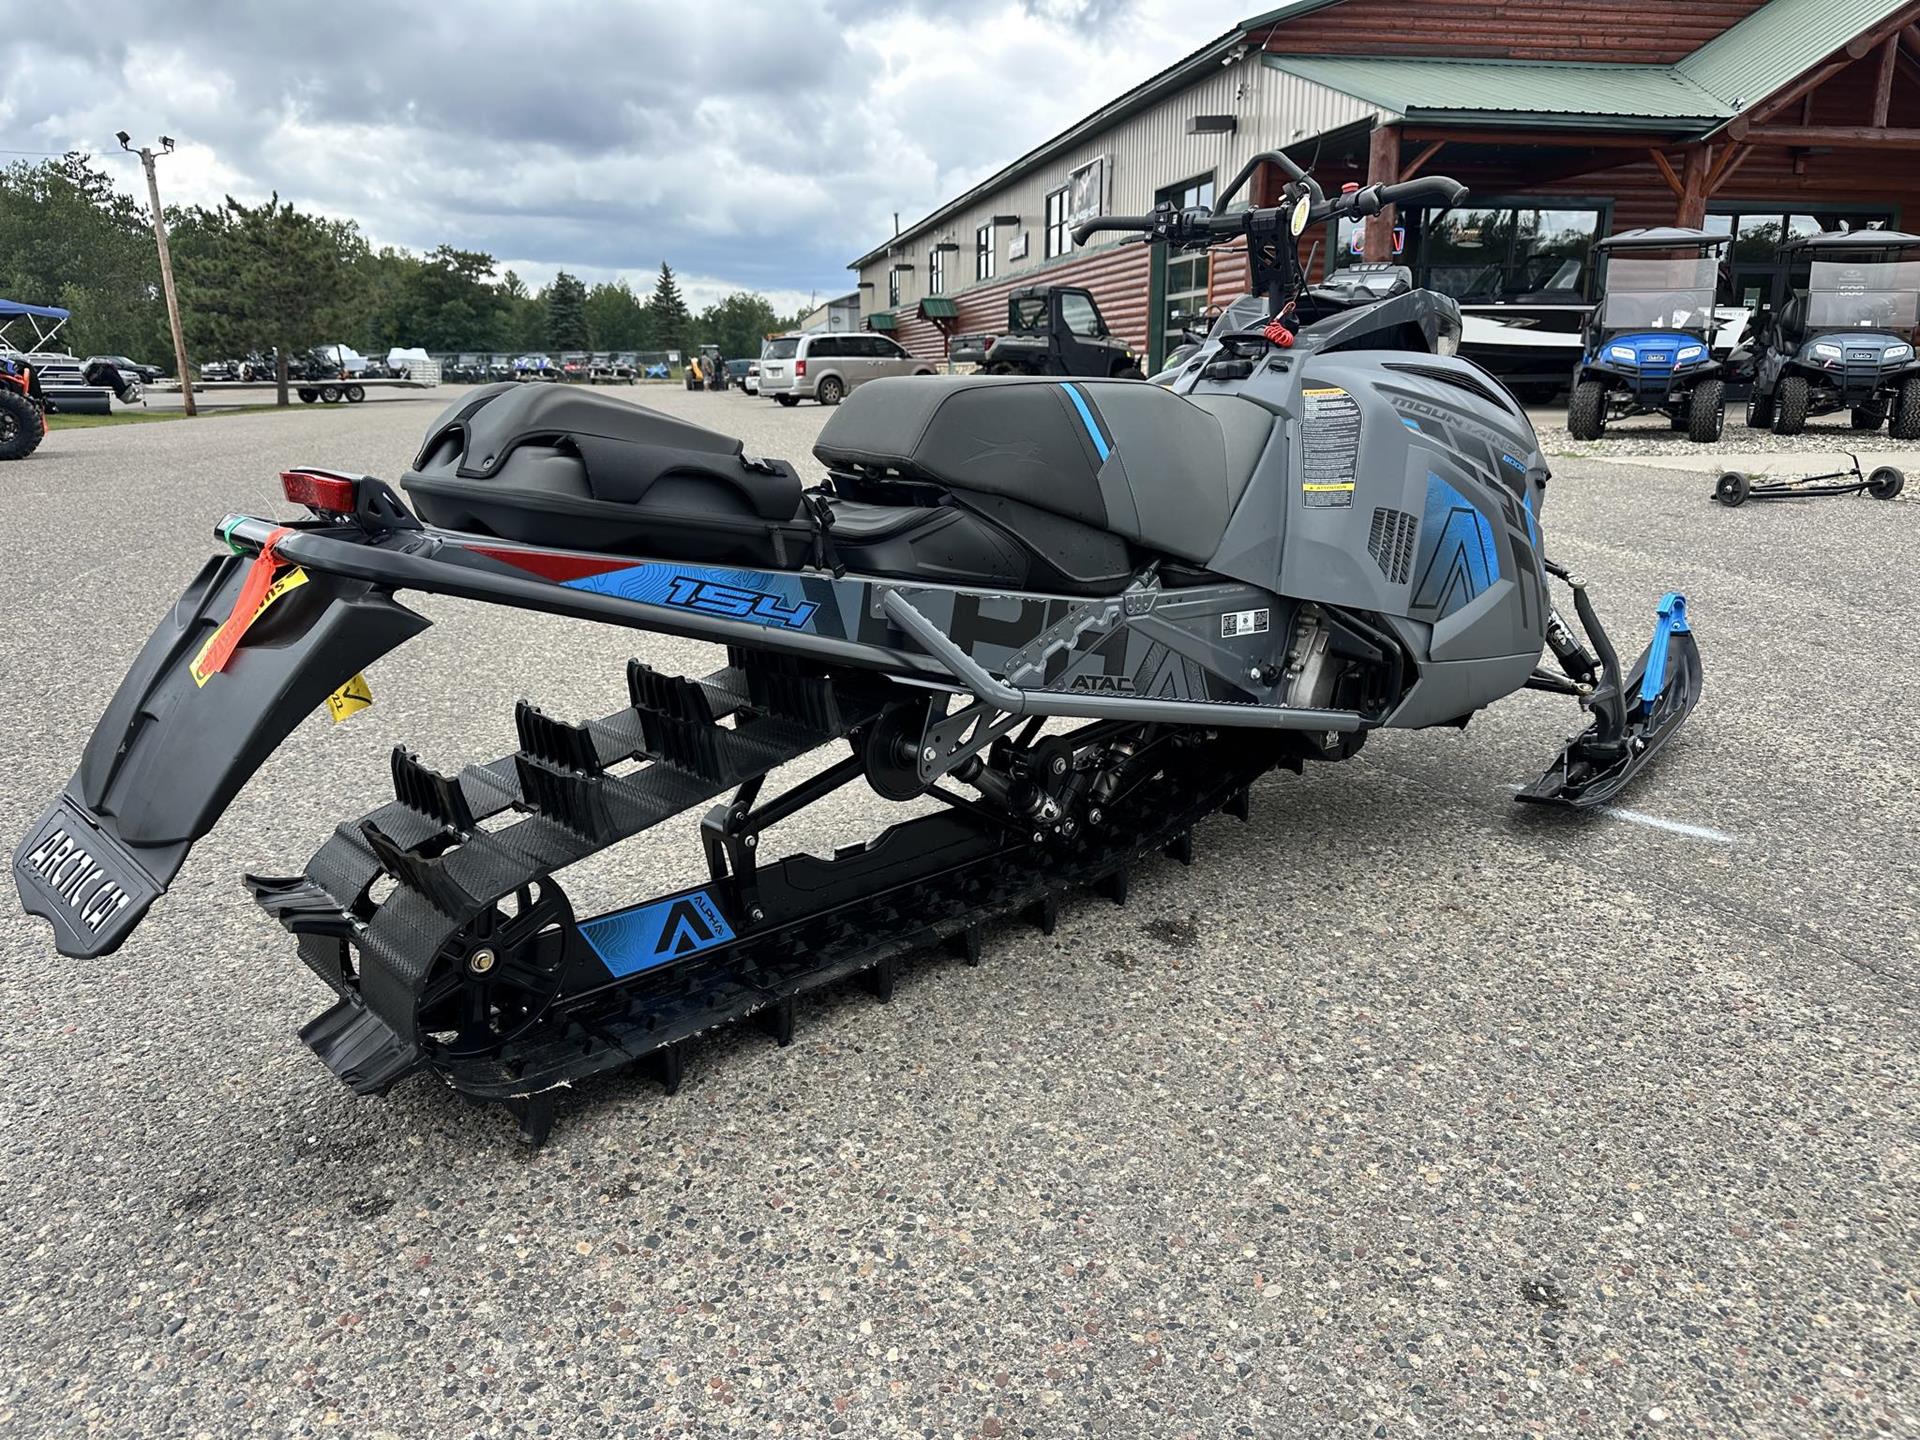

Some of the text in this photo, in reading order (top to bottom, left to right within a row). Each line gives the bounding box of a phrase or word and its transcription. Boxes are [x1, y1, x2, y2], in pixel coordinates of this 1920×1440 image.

[1391, 396, 1505, 449] MOUNTAIN
[664, 575, 821, 628] 154
[1071, 674, 1135, 691] ATAC
[26, 829, 130, 934] ARCTIC CAT
[694, 896, 724, 936] ALPHA
